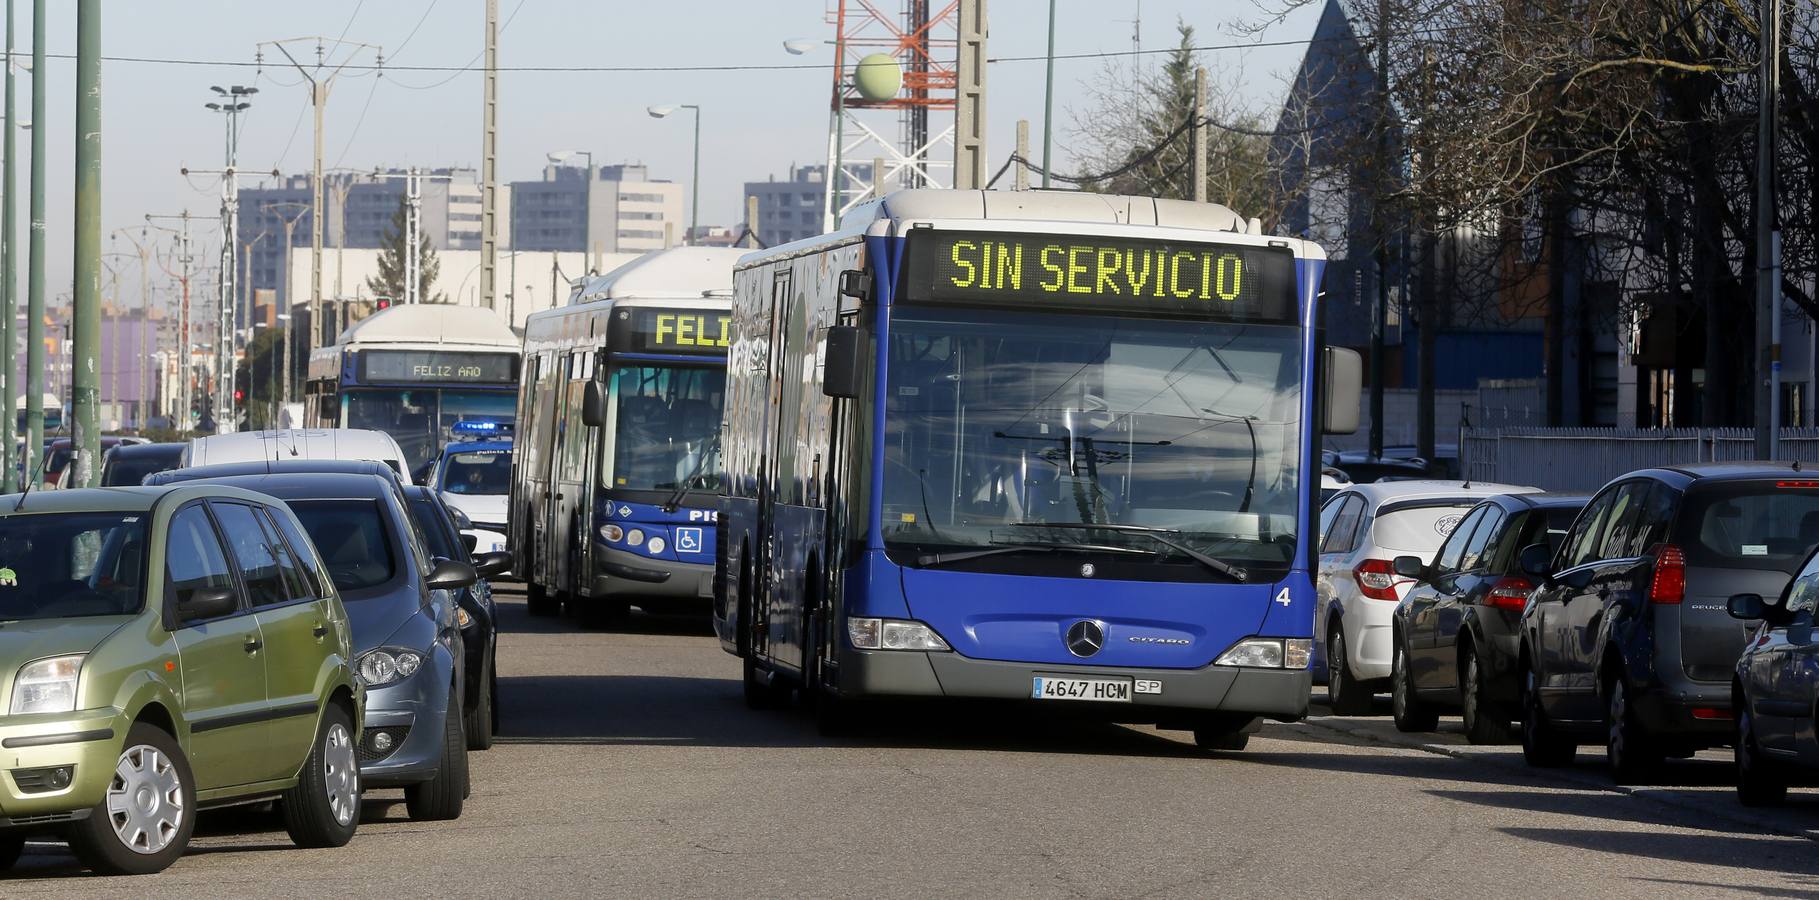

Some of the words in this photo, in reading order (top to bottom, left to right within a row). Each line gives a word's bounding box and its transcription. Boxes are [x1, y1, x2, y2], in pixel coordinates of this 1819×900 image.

[951, 240, 1023, 290] SIN
[1040, 244, 1242, 300] SERVICIO
[413, 365, 451, 376] FELIZ
[458, 366, 481, 377] AÑO
[1275, 587, 1291, 606] 4
[1129, 636, 1191, 645] CITARO
[1045, 680, 1089, 698] 4647
[1094, 682, 1128, 699] HCM
[1136, 681, 1160, 692] SP
